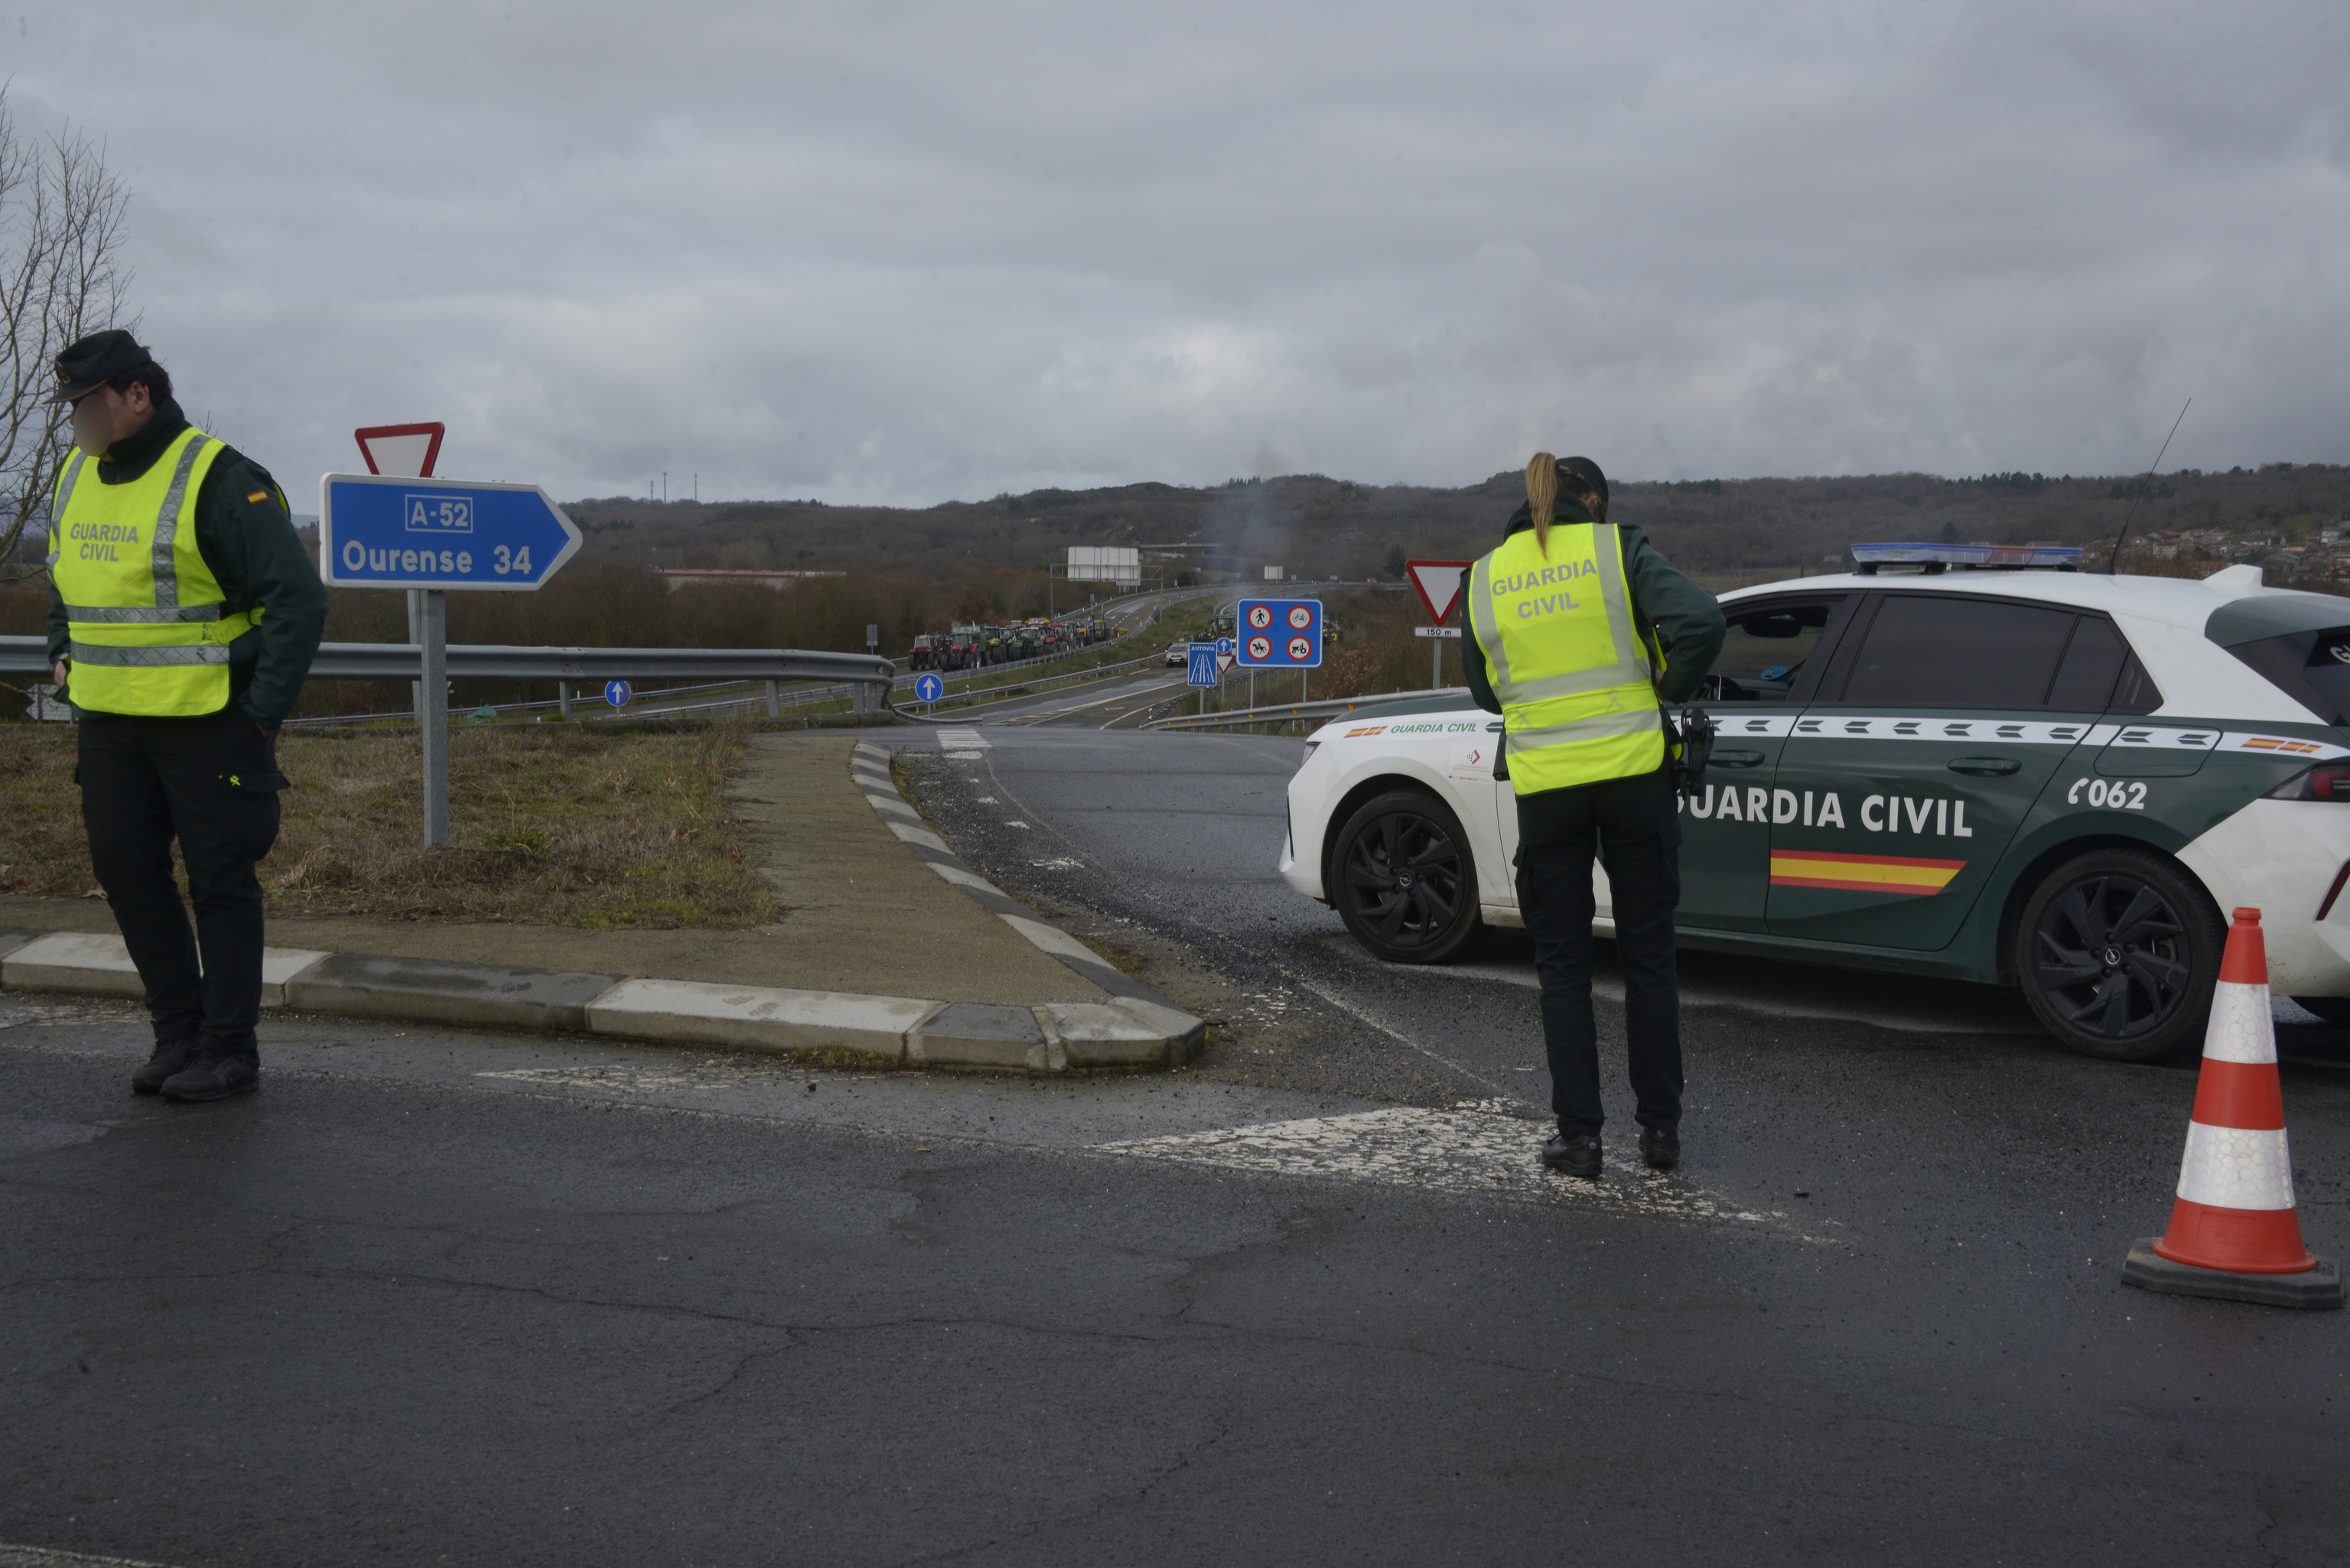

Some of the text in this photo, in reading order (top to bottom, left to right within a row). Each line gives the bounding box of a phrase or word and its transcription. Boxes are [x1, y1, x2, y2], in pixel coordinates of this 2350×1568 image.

[411, 501, 468, 527] A-52
[70, 522, 138, 544] GUARDIA
[80, 542, 119, 562] CIVIL
[343, 540, 532, 574] Ourense 34
[1492, 558, 1597, 596] GUARDIA
[1517, 592, 1580, 619] CIVIL
[1390, 723, 1476, 734] GUARDIA CIVIL
[2088, 779, 2147, 810] 062
[1860, 794, 1973, 838] CIVIL
